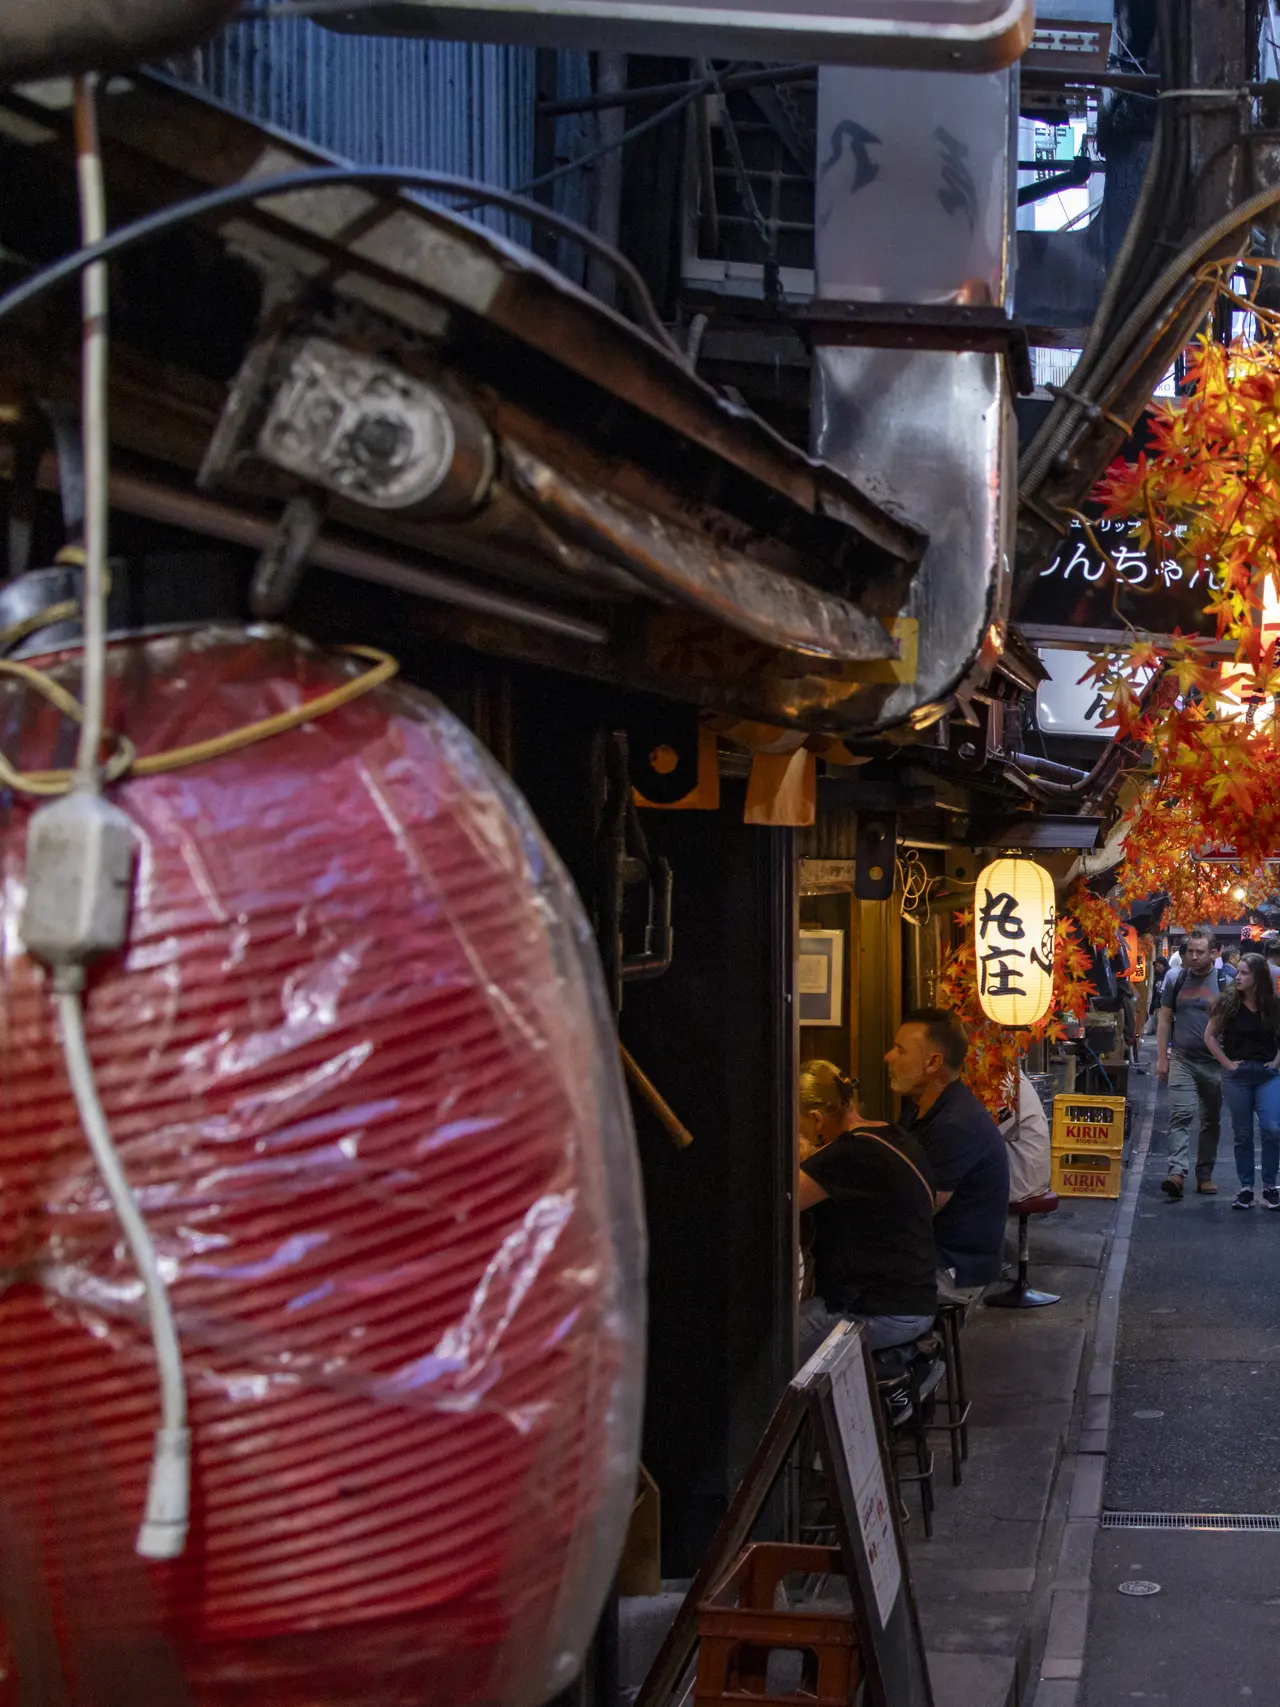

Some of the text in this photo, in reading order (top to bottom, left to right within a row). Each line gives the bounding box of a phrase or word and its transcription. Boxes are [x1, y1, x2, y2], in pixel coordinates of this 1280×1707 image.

[979, 888, 1027, 997] 丸庄
[1066, 1125, 1109, 1139] KIRIN
[1063, 1174, 1106, 1187] KIRIN
